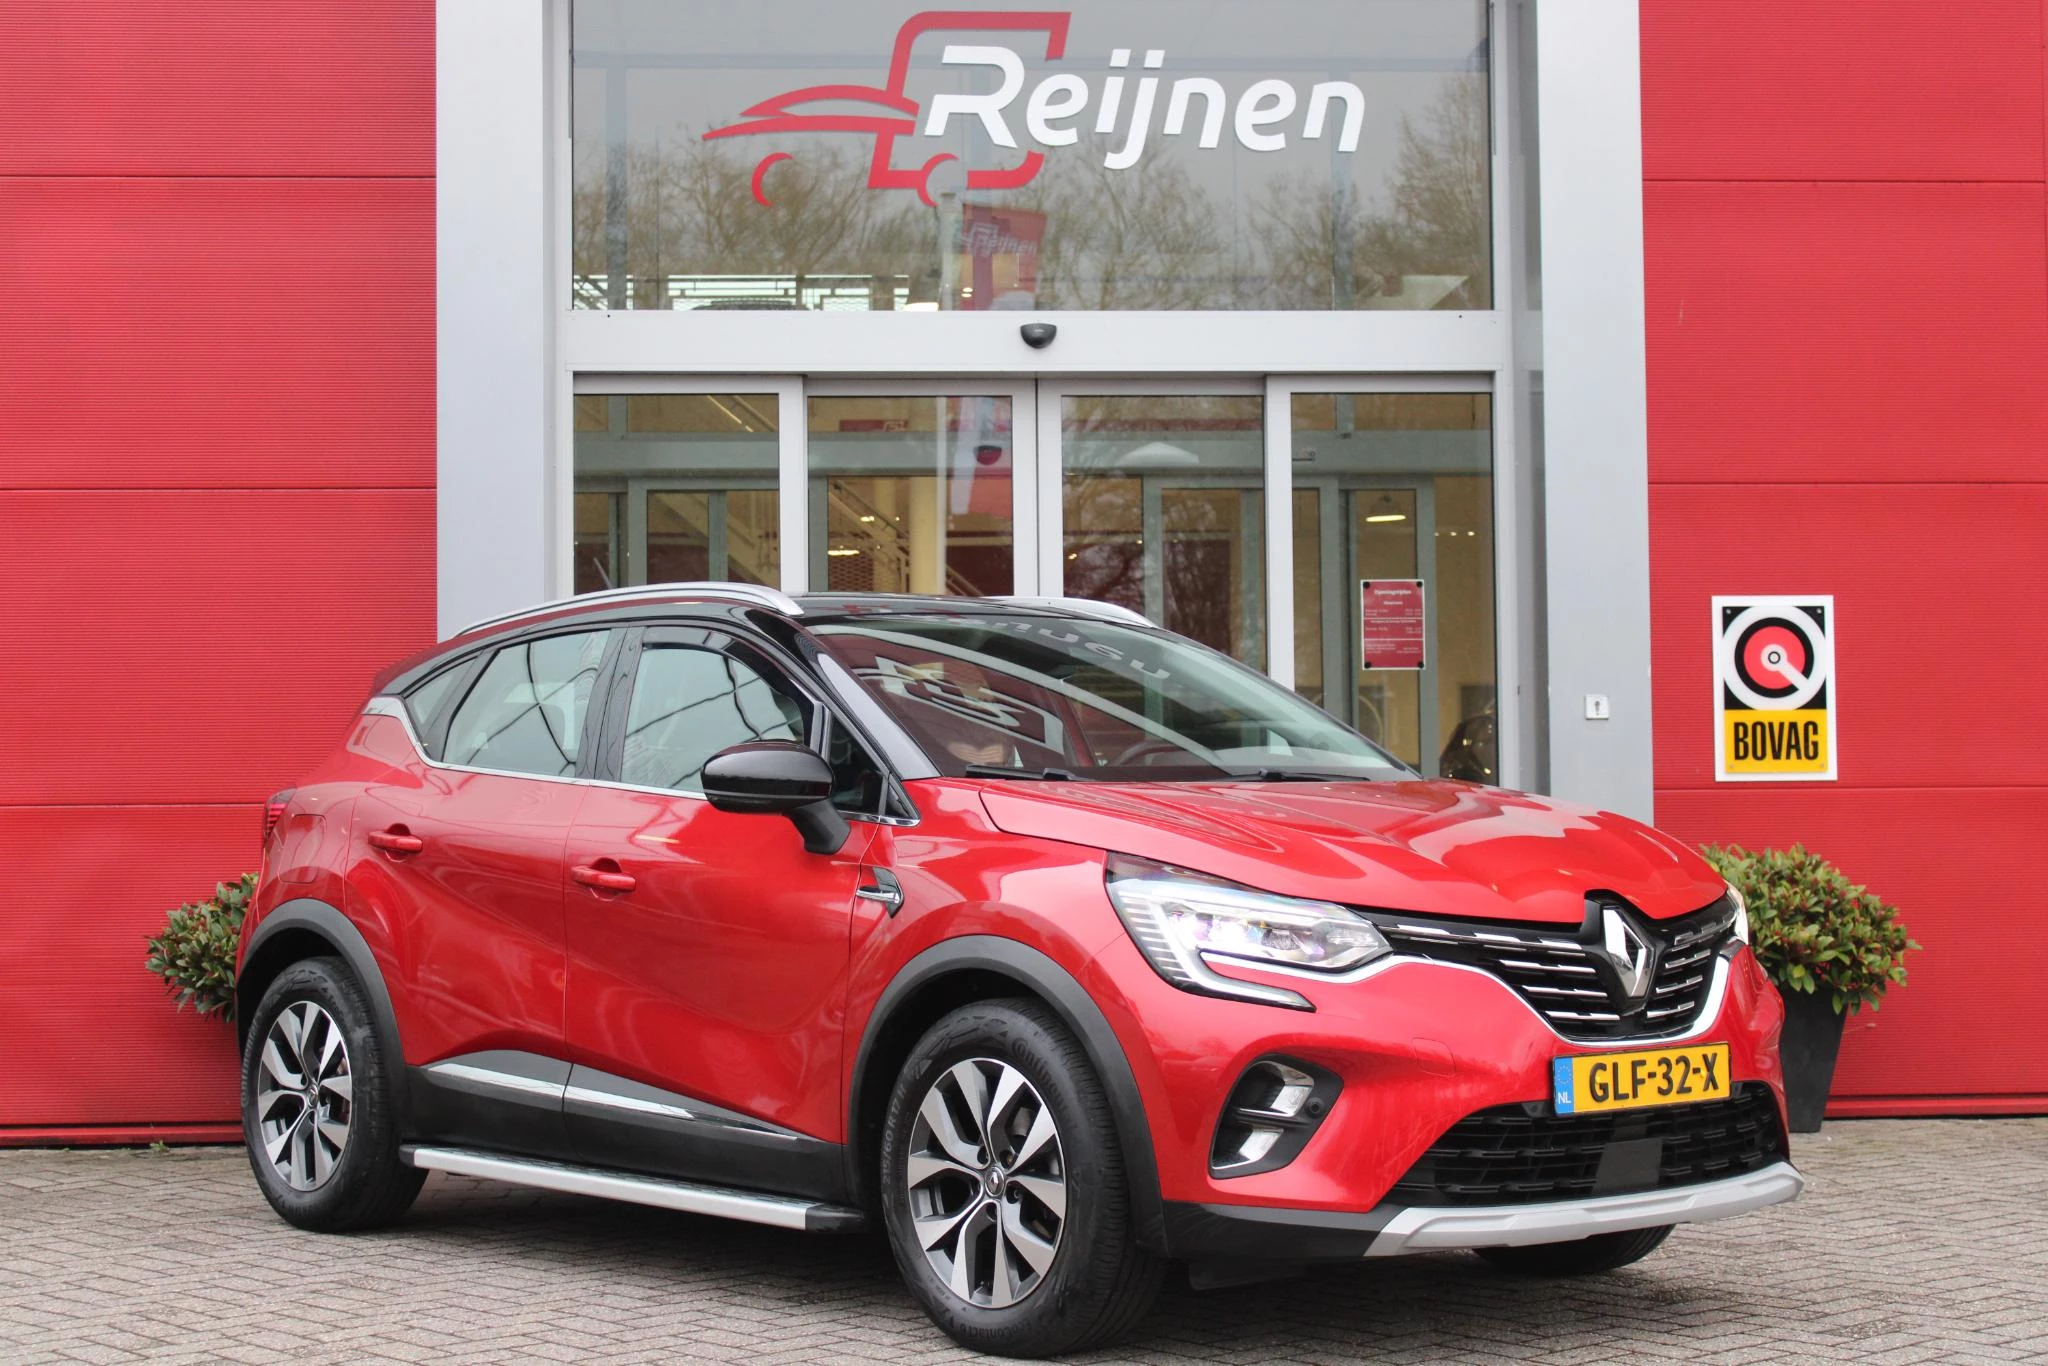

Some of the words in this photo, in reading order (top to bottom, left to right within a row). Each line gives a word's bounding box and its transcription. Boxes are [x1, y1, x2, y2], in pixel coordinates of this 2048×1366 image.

[923, 44, 1366, 170] Reijnen
[1733, 721, 1819, 761] BOVAG
[1557, 1091, 1572, 1105] NL
[1588, 1052, 1720, 1104] GLF-32-X
